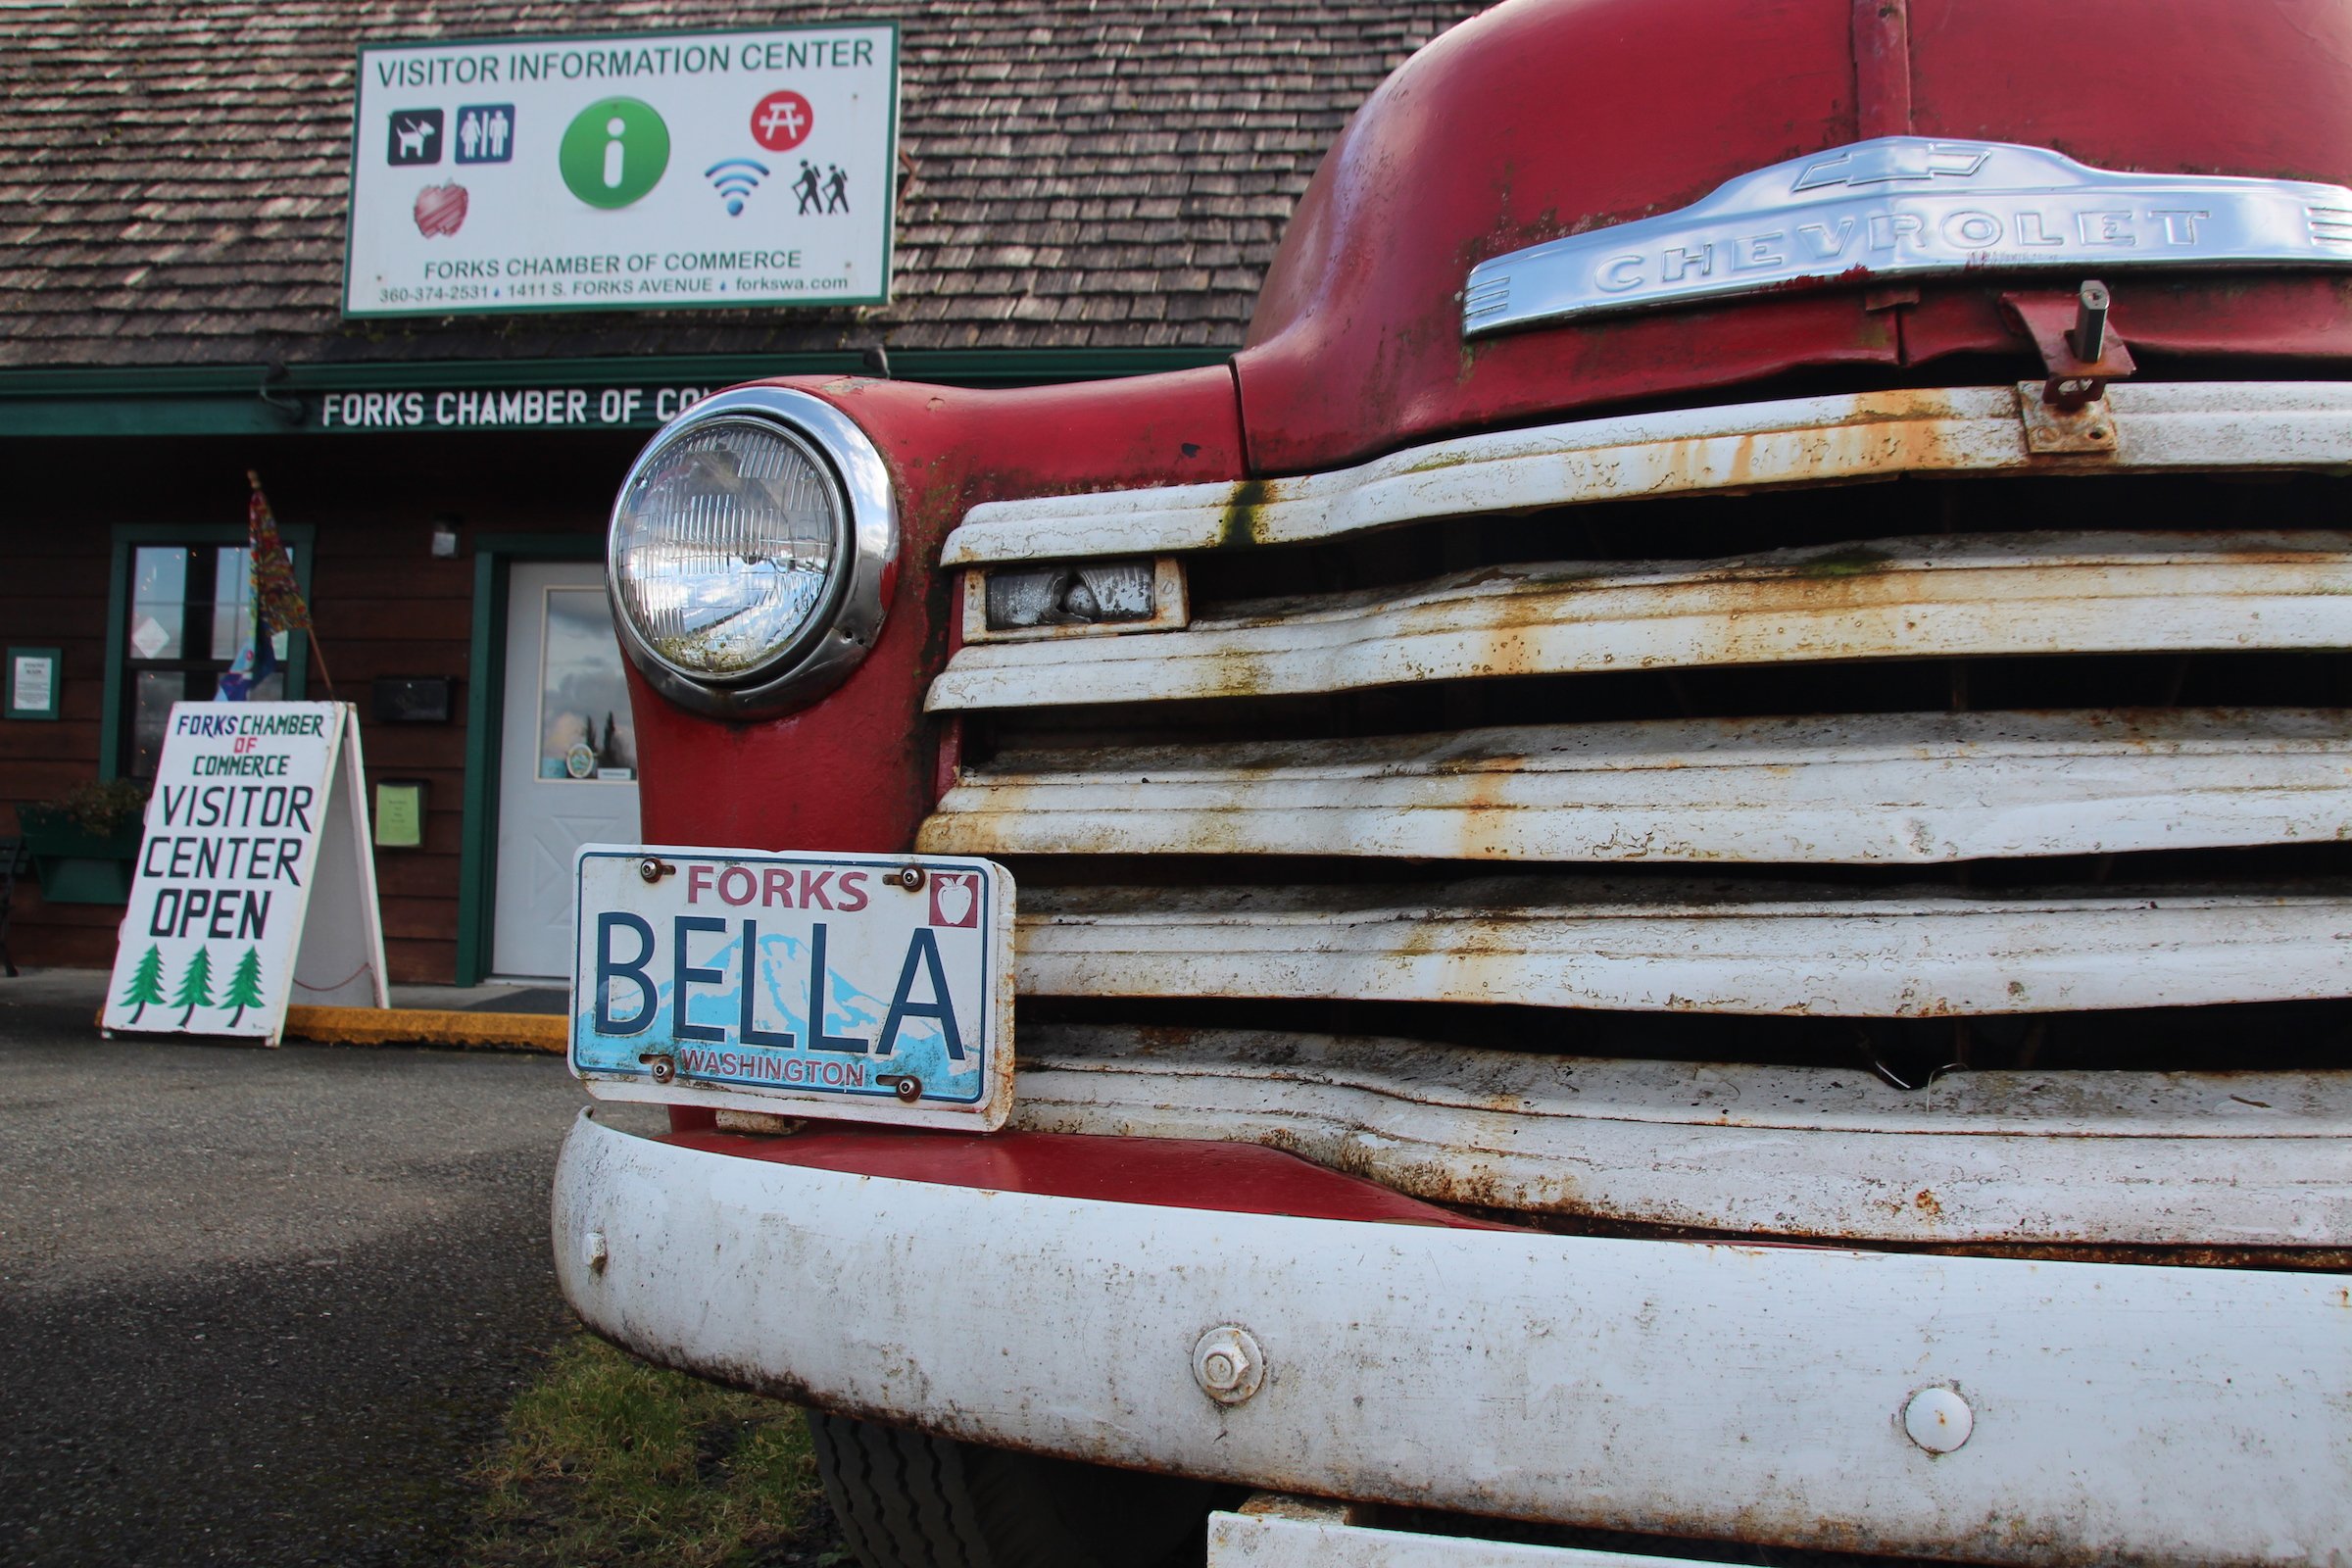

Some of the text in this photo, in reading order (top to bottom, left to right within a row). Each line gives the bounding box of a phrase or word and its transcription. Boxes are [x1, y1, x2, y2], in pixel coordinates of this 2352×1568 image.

[378, 39, 872, 87] VISITOR INFORMATION CENTER
[424, 250, 802, 279] FORKS CHAMBER OF COMMERCE
[1593, 210, 2210, 292] CHEVROLET
[379, 276, 848, 303] 360-374-2531 1411 S. FORKS AVENUE forkswa.com
[322, 386, 710, 426] FORKS CHAMBER OF CO
[177, 713, 324, 738] FORKS CHAMBER
[233, 737, 258, 754] OF
[192, 755, 290, 778] COMMERCE
[163, 785, 314, 833] VISITOR
[143, 836, 303, 886] CENTER
[688, 865, 868, 912] FORKS
[149, 888, 272, 939] OPEN
[595, 911, 965, 1060] BELLA
[680, 1048, 865, 1087] WASHINGTON
